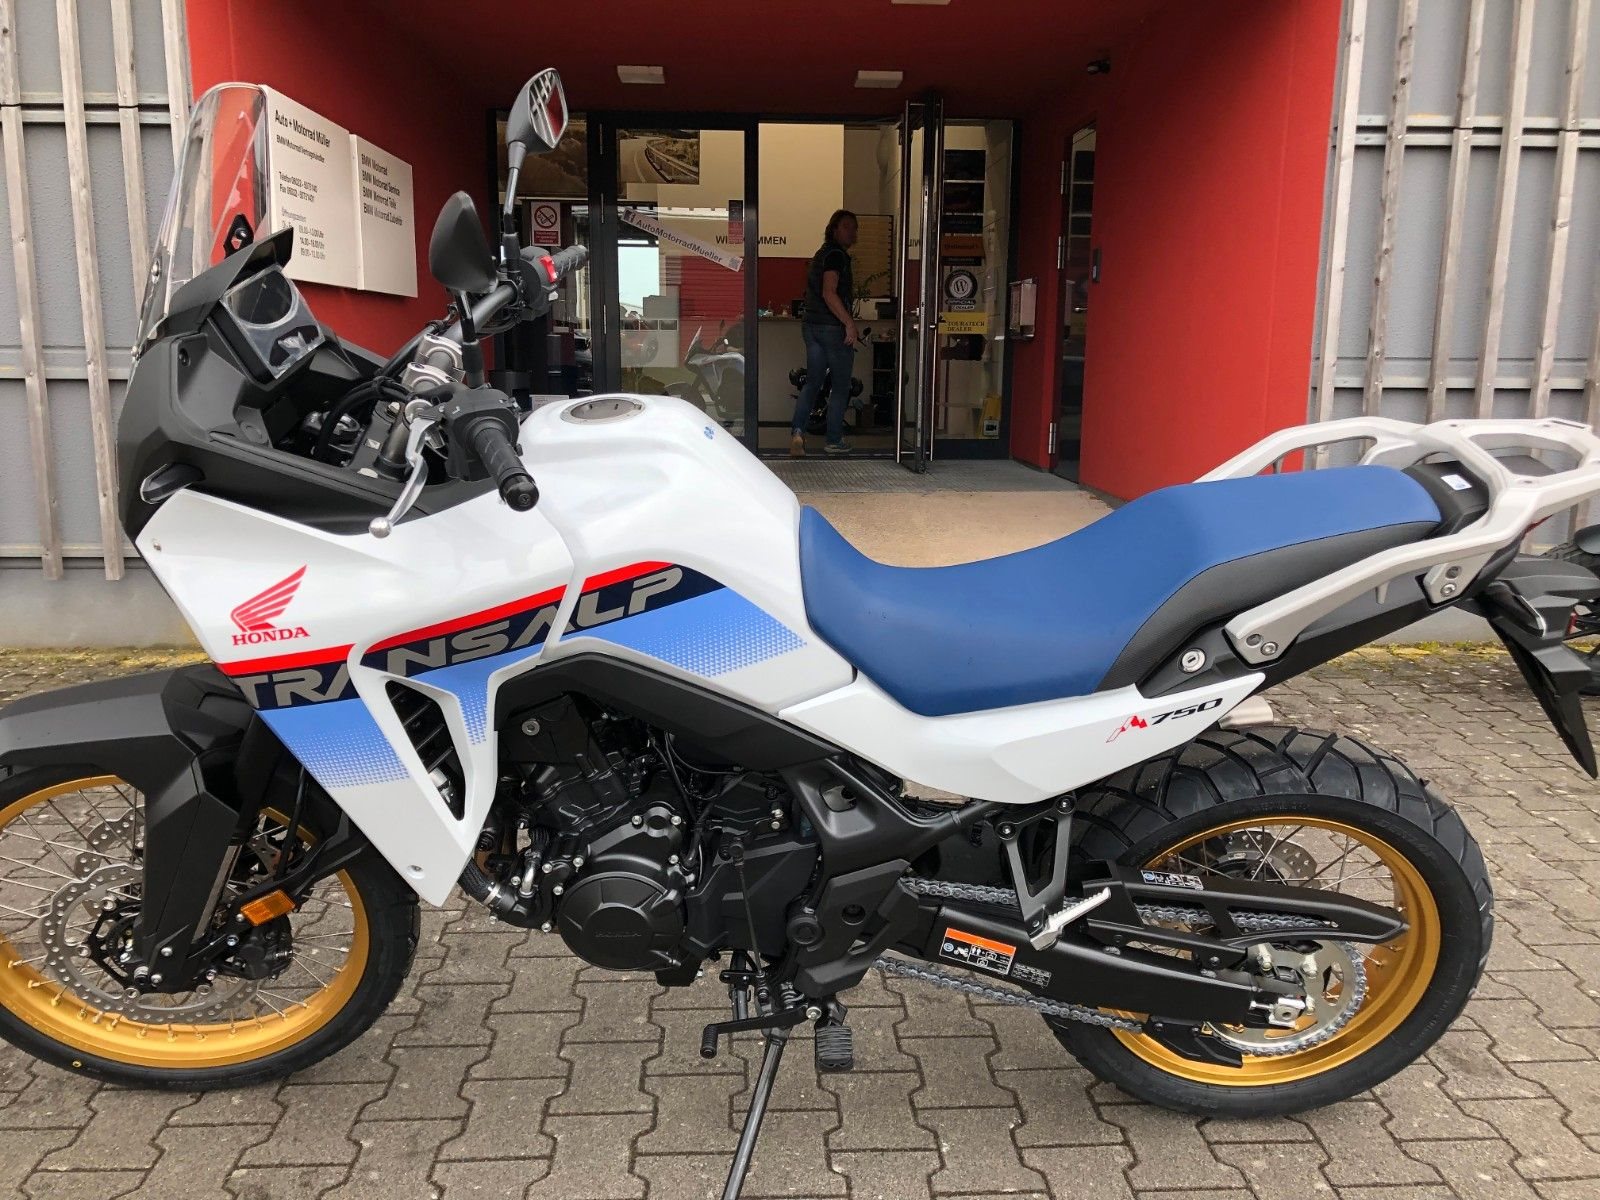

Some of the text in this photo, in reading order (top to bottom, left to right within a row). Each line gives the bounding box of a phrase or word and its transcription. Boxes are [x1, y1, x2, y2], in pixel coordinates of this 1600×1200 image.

[275, 109, 288, 127] Auto
[293, 118, 315, 141] Motorrad
[316, 130, 330, 147] Müller
[362, 153, 387, 176] BMW Motorrad
[362, 170, 372, 184] BMW
[373, 175, 388, 191] Motorrad
[363, 186, 372, 200] BMW
[364, 202, 373, 215] BMW
[636, 220, 723, 263] AutoMotorradMueller
[231, 626, 311, 646] HONDA
[1151, 697, 1223, 726] 750
